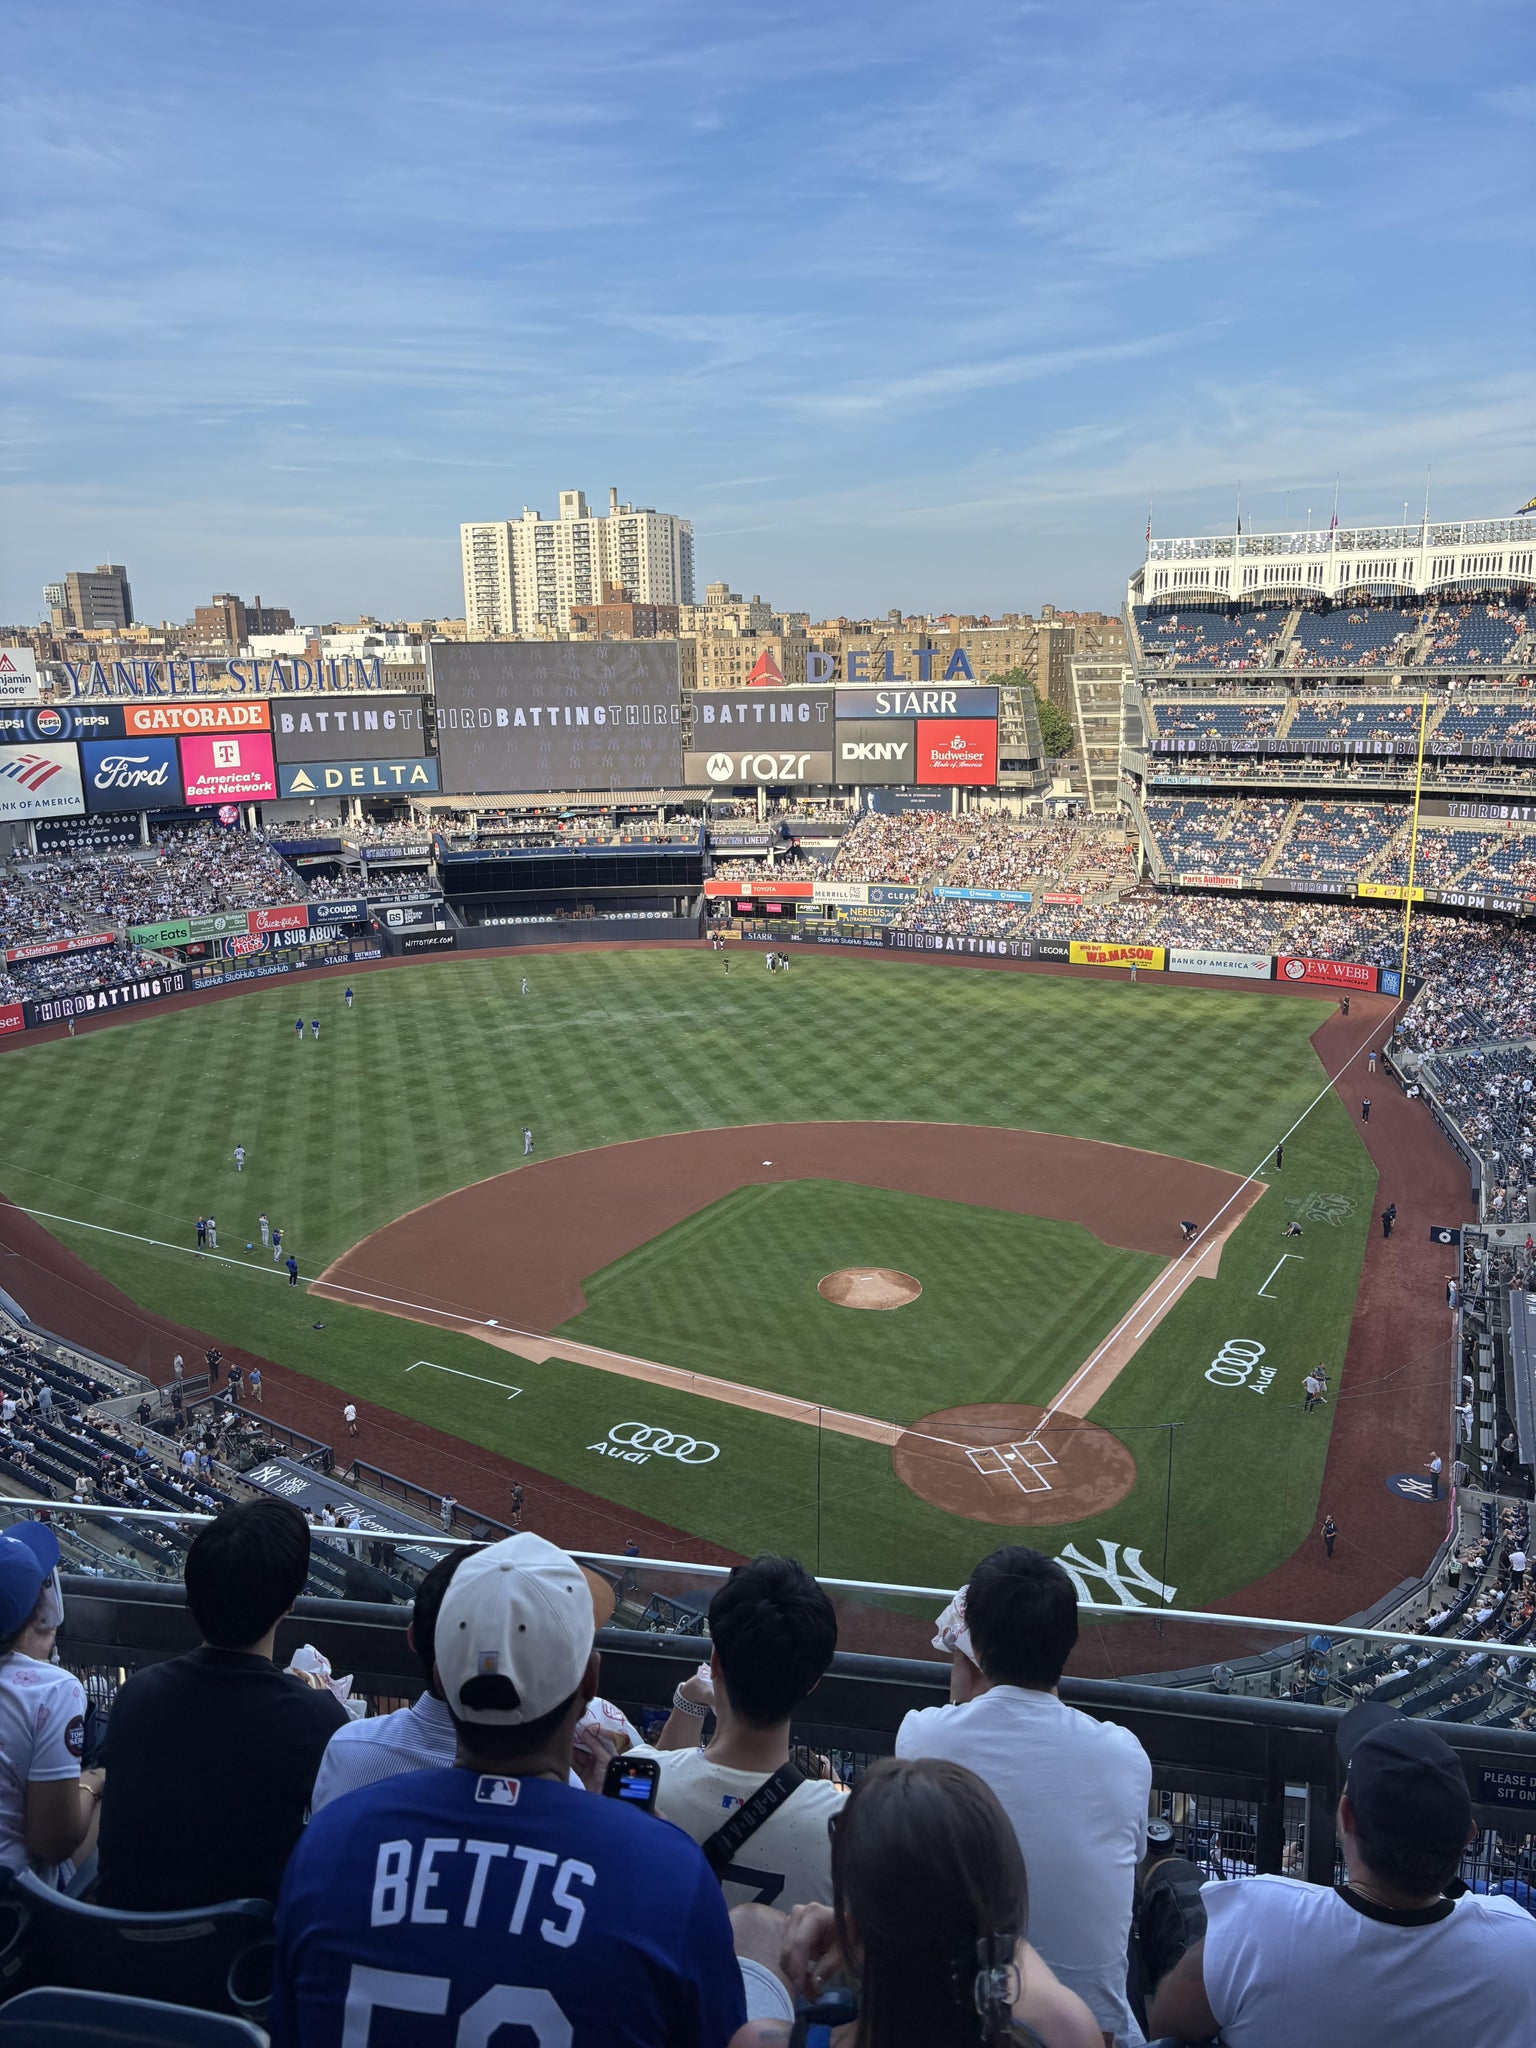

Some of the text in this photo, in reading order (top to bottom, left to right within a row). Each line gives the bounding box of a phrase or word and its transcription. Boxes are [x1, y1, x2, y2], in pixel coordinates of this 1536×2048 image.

[806, 648, 976, 683] DELTA
[62, 658, 384, 697] YANKEE STADIUM
[0, 686, 26, 694] oore
[874, 691, 957, 714] STARR
[74, 716, 109, 727] PEPSI
[133, 705, 263, 730] GATORADE
[841, 742, 909, 760] DKNY
[930, 749, 985, 761] Budweiser
[94, 756, 169, 789] Ford
[740, 754, 811, 780] razr
[196, 772, 262, 785] America's
[325, 765, 430, 788] DELTA
[187, 781, 273, 796] Best Network
[0, 797, 81, 811] NK OF AMERICA
[744, 836, 769, 845] LINEUP
[403, 846, 430, 855] LINEUP
[1183, 875, 1239, 885] Parts Authority
[887, 892, 916, 900] CLEAR
[1441, 892, 1521, 912] 7:00 PM 84.9°F
[329, 904, 357, 915] coupa
[389, 914, 401, 922] GS
[132, 932, 159, 944] Uber
[160, 928, 188, 941] Eats
[273, 924, 343, 947] A SUB ABOVE
[748, 933, 773, 941] STARR
[817, 936, 840, 944] StubHub
[863, 939, 884, 947] StubHub
[1039, 946, 1069, 955] LEGORA
[324, 954, 349, 965] STARR
[1171, 957, 1249, 969] BANK OF AMERICA
[195, 964, 289, 989] StubHub StubHub StubHub
[1307, 961, 1370, 980] F.W. WEBB
[1248, 1365, 1278, 1395] Audi
[585, 1441, 652, 1465] Audi
[1483, 1771, 1526, 1786] PLEASE
[1497, 1787, 1536, 1801] SIT ON
[371, 1837, 597, 1949] BETTS
